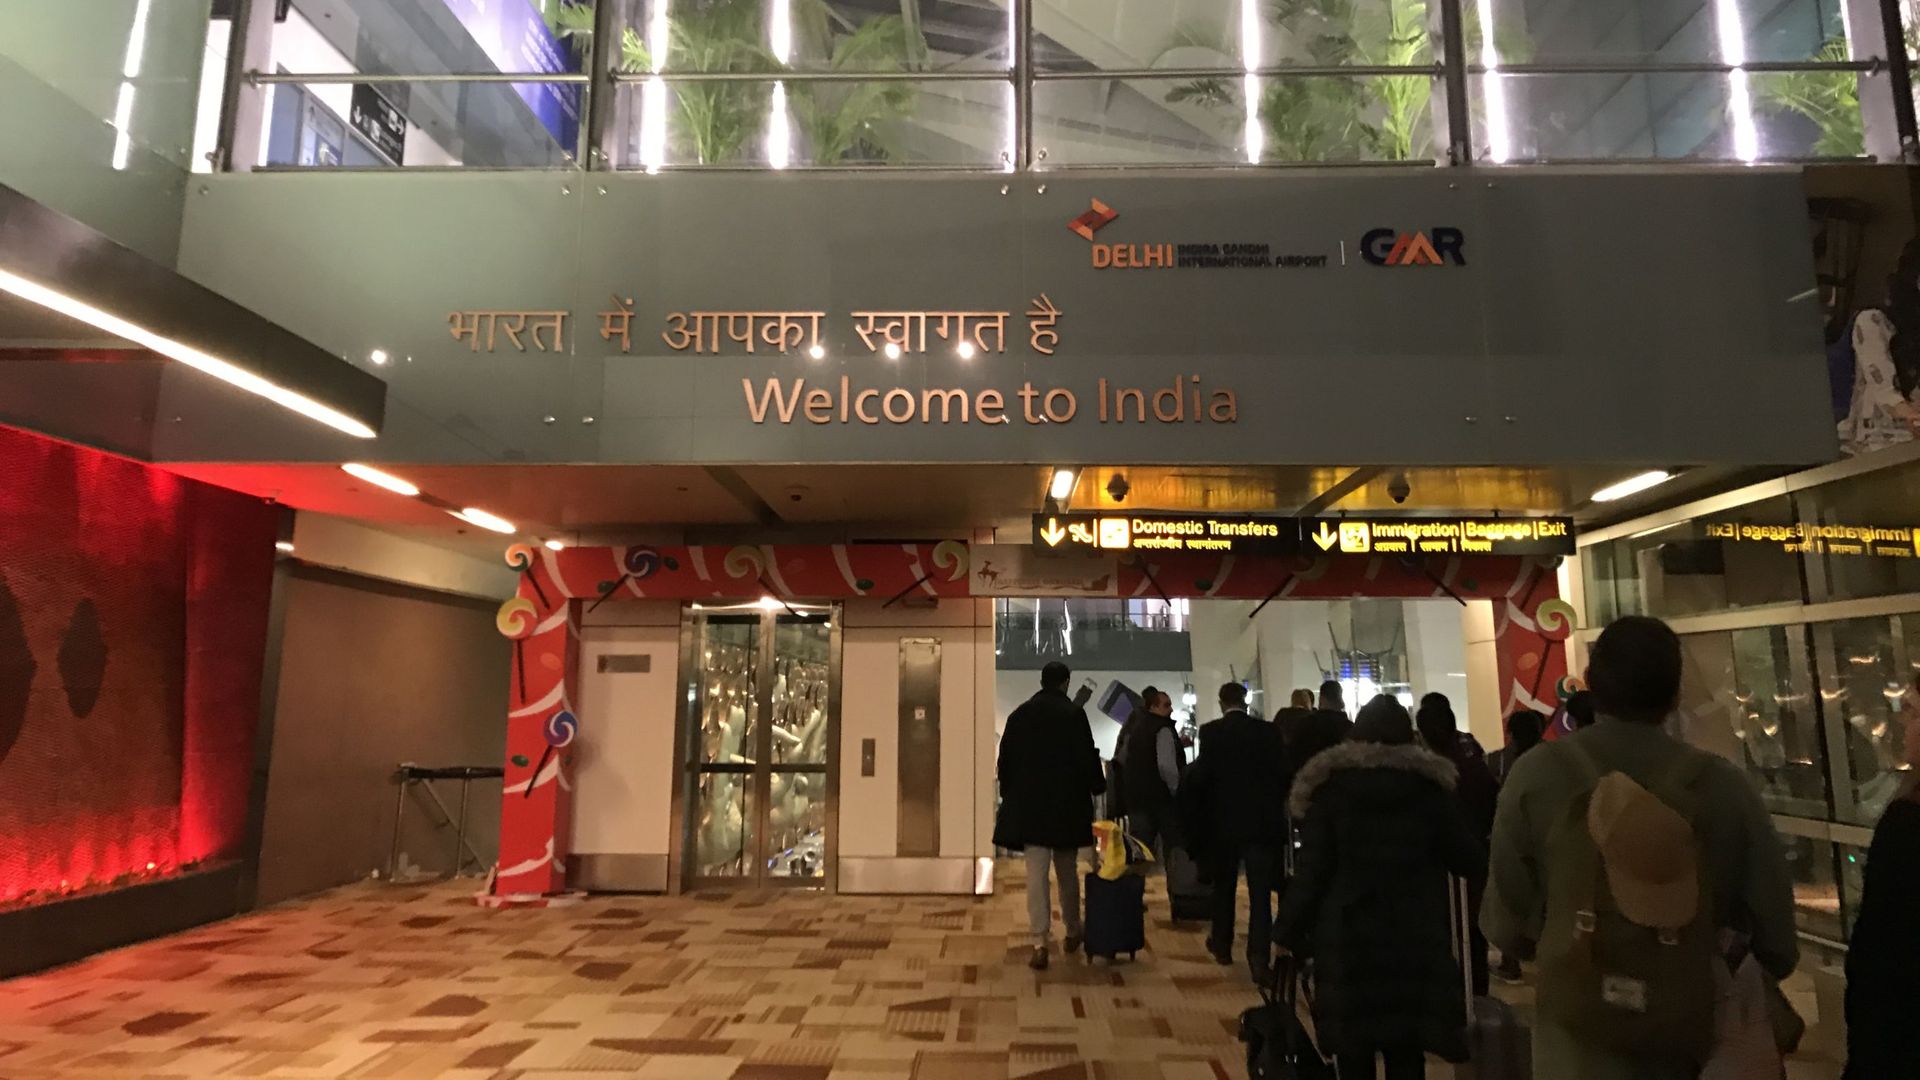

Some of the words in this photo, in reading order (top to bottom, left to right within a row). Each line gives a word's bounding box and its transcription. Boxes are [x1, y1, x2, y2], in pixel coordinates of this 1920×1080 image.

[1092, 243, 1174, 269] DELHI
[1360, 227, 1466, 267] GMR
[1178, 256, 1272, 268] INTERNATIONAL
[1275, 255, 1328, 268] AIRPORT
[448, 310, 570, 353] भारत
[599, 297, 636, 353] में
[662, 310, 826, 356] आपका
[850, 310, 1009, 356] स्वागत
[1025, 292, 1063, 356] है
[742, 374, 1005, 426] Welcome
[1018, 383, 1077, 426] to
[1098, 373, 1239, 425] India
[1132, 518, 1203, 535] Domestic
[1207, 520, 1278, 537] Transfers
[1372, 522, 1459, 540] Immigration
[1466, 521, 1531, 541] Baggage
[1539, 521, 1567, 537] Exit
